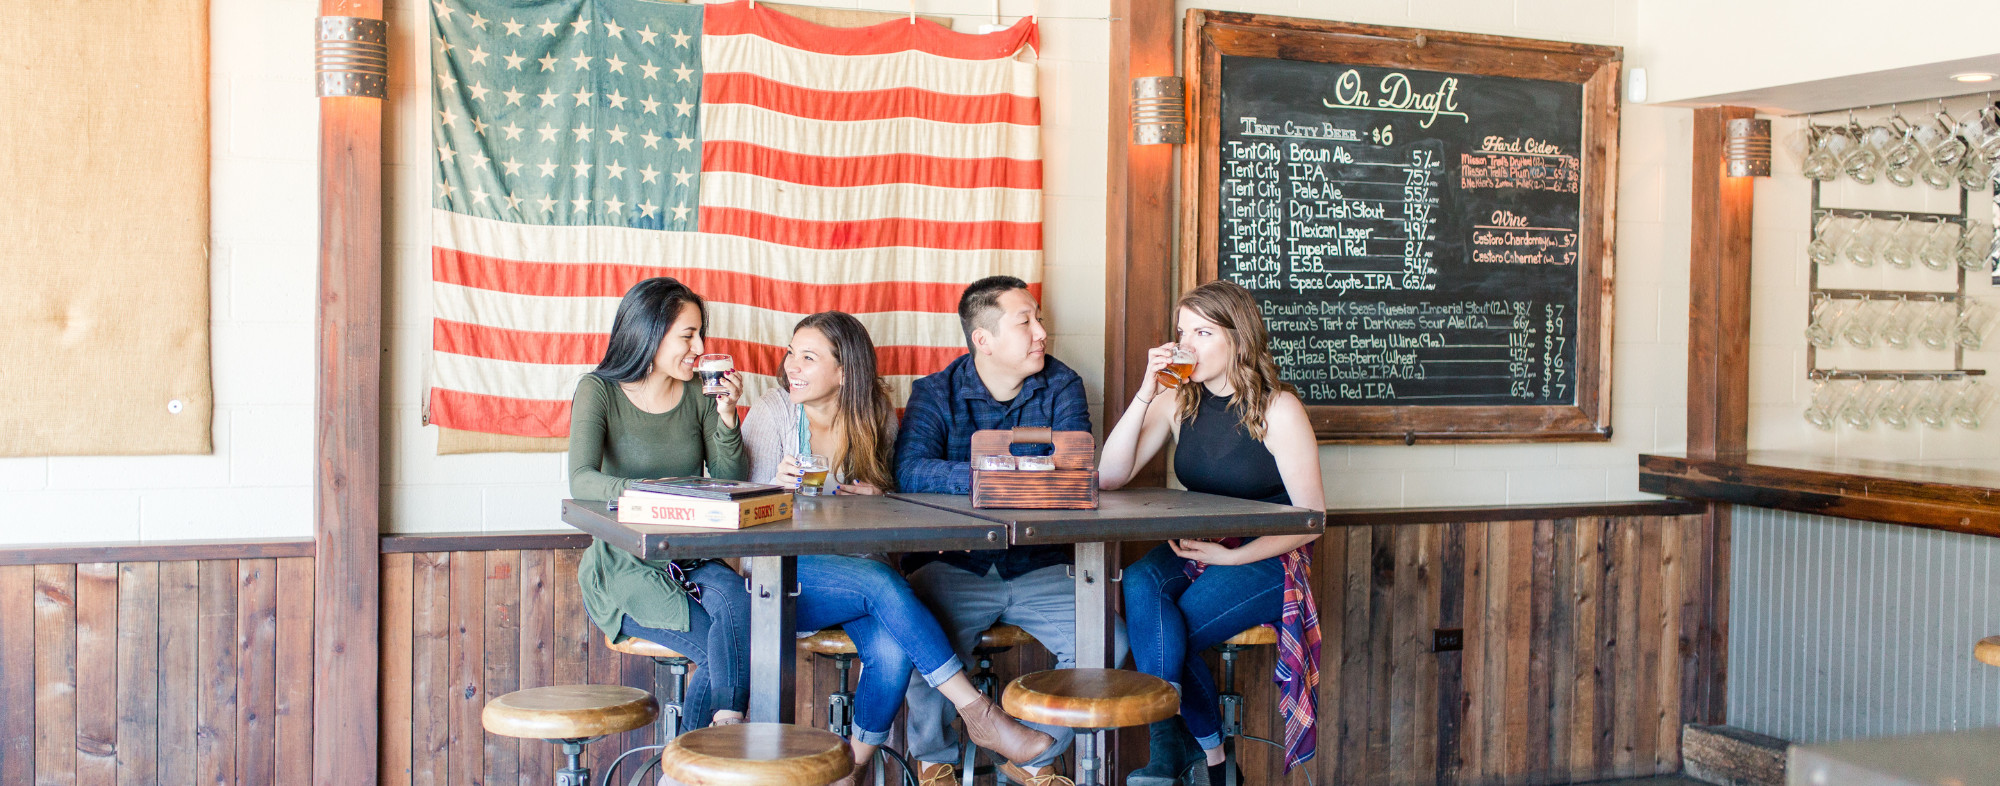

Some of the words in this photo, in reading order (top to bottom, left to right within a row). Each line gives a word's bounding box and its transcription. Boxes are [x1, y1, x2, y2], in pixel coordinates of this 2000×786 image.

[1336, 69, 1370, 106] On
[1378, 72, 1458, 128] Draft
[1372, 124, 1393, 146] $6
[1228, 142, 1257, 158] Tent
[1257, 142, 1280, 165] City
[1290, 143, 1330, 162] Brown
[1333, 146, 1354, 164] Ale
[1482, 135, 1521, 152] Hard
[1524, 137, 1561, 155] Cider
[1227, 161, 1254, 177] Tent
[1256, 162, 1279, 183] City
[1288, 163, 1328, 182] I.P.A.
[1509, 167, 1531, 179] Plum
[1227, 179, 1255, 196] Tent
[1258, 180, 1281, 203] City
[1292, 181, 1319, 198] Pale
[1322, 182, 1343, 199] Ale
[1228, 198, 1256, 217] Tent
[1258, 199, 1281, 224] City
[1290, 200, 1313, 223] Dry
[1315, 199, 1351, 219] Irish
[1352, 201, 1385, 219] Stout
[1491, 210, 1529, 227] Wine
[1229, 219, 1257, 236] Tent
[1258, 218, 1280, 242] City
[1290, 220, 1337, 238] Mexican
[1338, 222, 1374, 244] Lager
[1564, 233, 1577, 247] $7
[1229, 236, 1256, 253] Tent
[1258, 237, 1280, 259] City
[1287, 237, 1342, 257] Imperial
[1344, 240, 1367, 256] Red
[1404, 241, 1423, 257] 8%
[1230, 255, 1257, 271] Tent
[1258, 255, 1280, 277] City
[1290, 256, 1326, 272] E.S.B.
[1564, 252, 1577, 265] $7
[1258, 273, 1281, 289] City
[1289, 274, 1324, 294] Space
[1325, 273, 1364, 296] Coyote
[1321, 301, 1346, 315] Dark
[1350, 302, 1376, 315] Seas
[1378, 301, 1419, 316] Russian
[1420, 301, 1463, 314] Imperial
[1465, 301, 1490, 314] Stout
[1319, 317, 1343, 331] Tart
[1346, 317, 1358, 330] of
[1363, 316, 1416, 330] Darkness
[1419, 315, 1445, 329] Sour
[1447, 315, 1465, 329] Ale
[1267, 336, 1306, 353] ckeyed
[1309, 336, 1347, 350] Cooper
[1350, 334, 1386, 350] Barley
[1389, 334, 1419, 348] Wine
[1273, 349, 1295, 366] rple
[1297, 350, 1326, 365] Haze
[1329, 349, 1384, 368] Raspberry
[1386, 349, 1418, 364] Wheat
[1330, 365, 1369, 380] Double
[1340, 384, 1362, 399] Red
[651, 506, 695, 521] SORRY!
[754, 504, 775, 520] SORRY!
